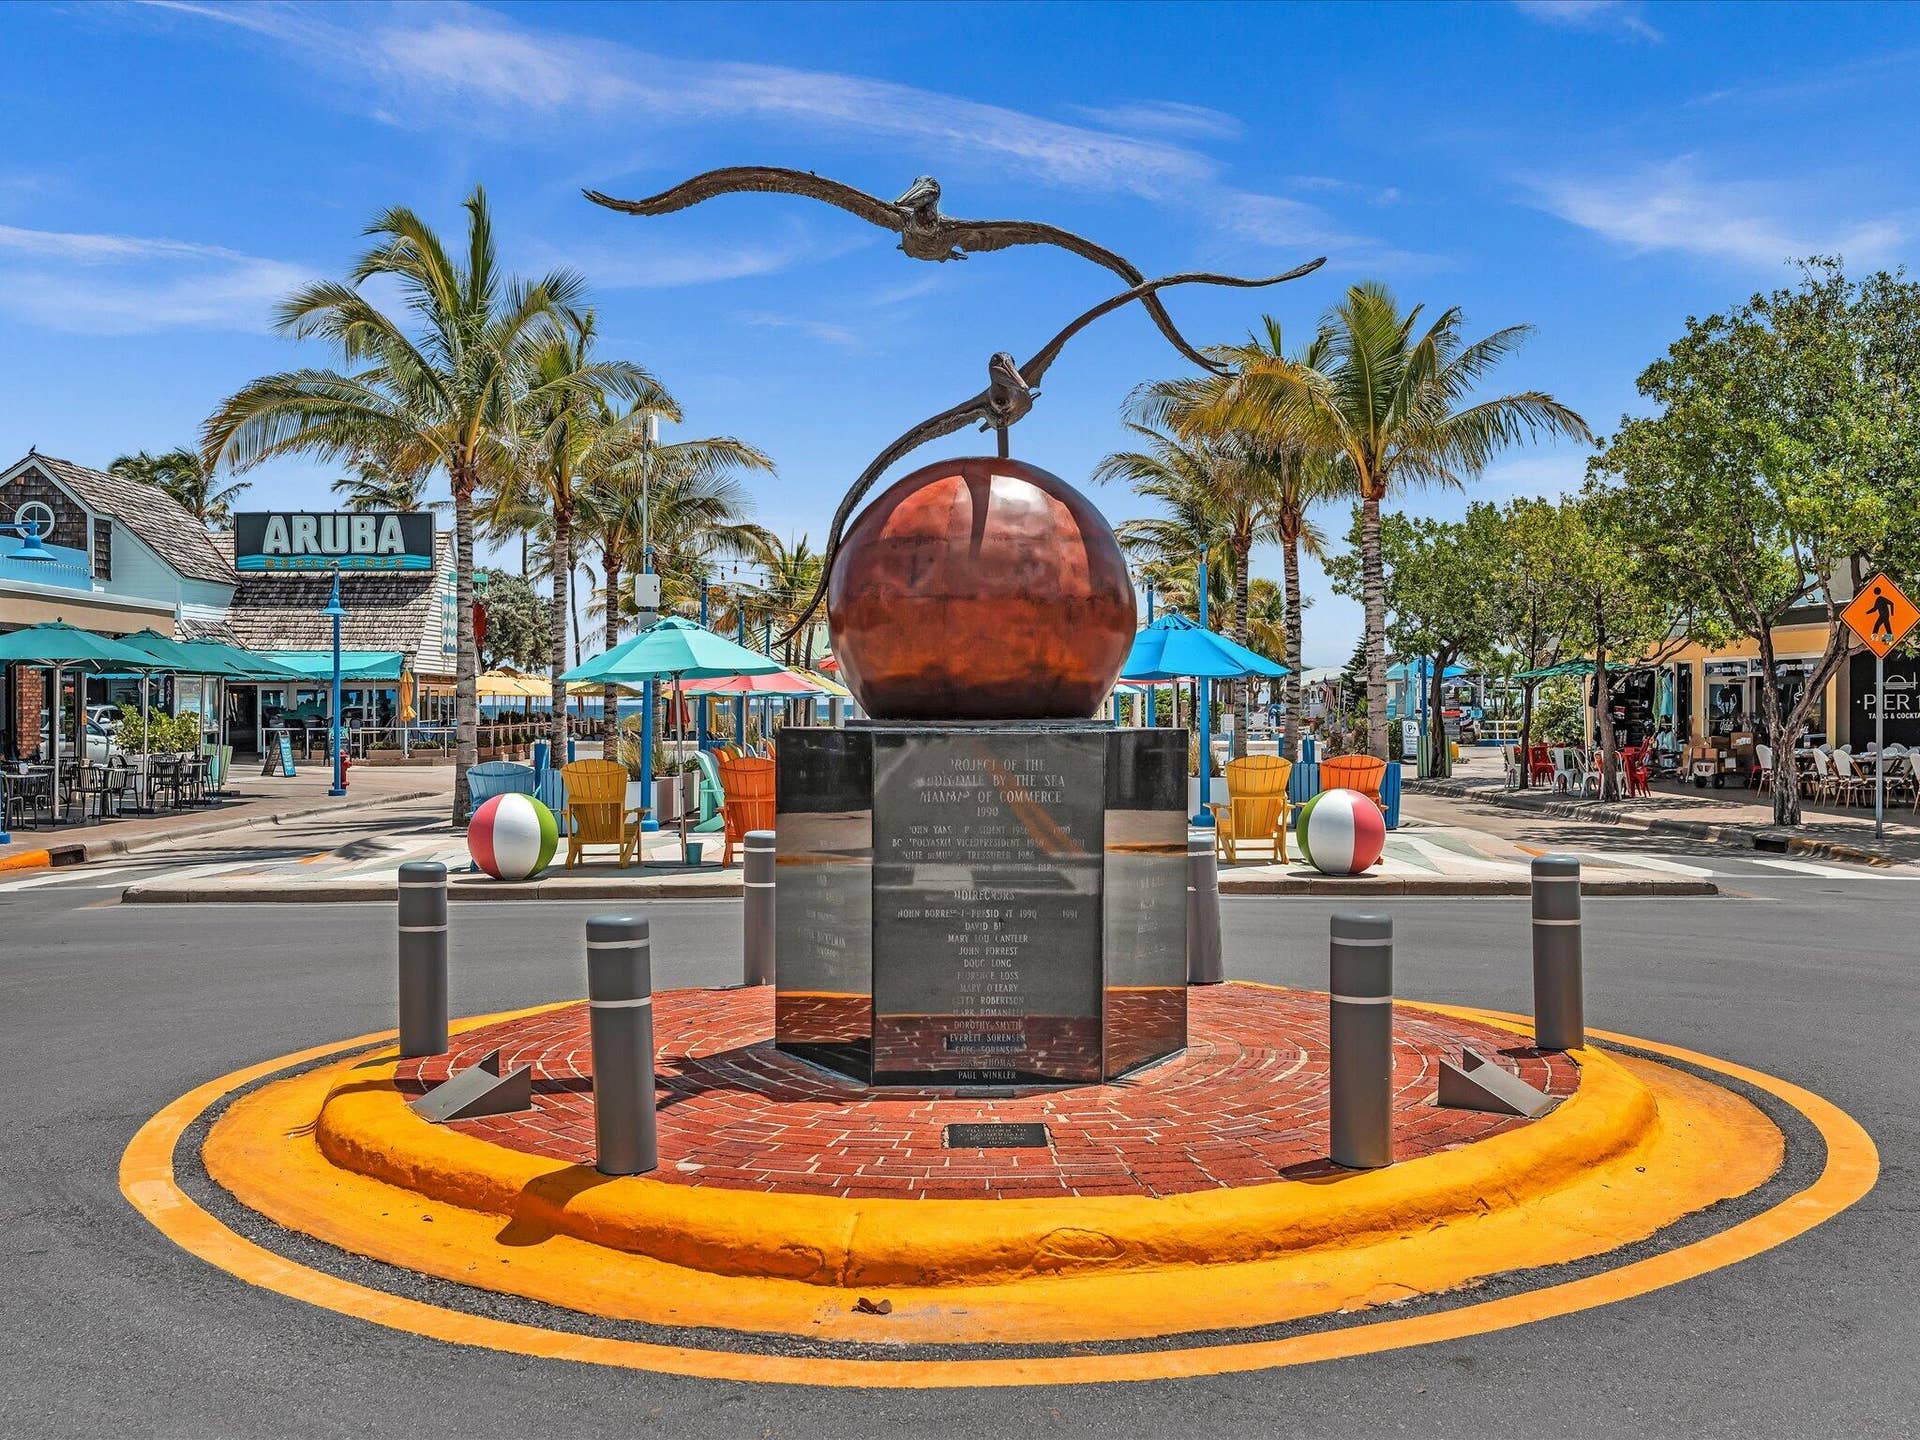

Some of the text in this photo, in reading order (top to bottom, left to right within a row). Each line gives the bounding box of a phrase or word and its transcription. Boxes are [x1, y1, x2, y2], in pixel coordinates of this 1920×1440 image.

[262, 515, 406, 554] ARUBA
[1863, 693, 1911, 711] PER
[1003, 758, 1018, 771] OF
[1025, 758, 1046, 771] THE
[993, 774, 1006, 786] BY
[1014, 774, 1037, 786] THE
[1044, 774, 1065, 786] SEA
[977, 790, 993, 803] OF
[1000, 790, 1062, 803] COMMERCE
[976, 806, 999, 817] 1990
[964, 922, 988, 931] DAVID
[947, 934, 969, 943] MARY
[958, 946, 1018, 955] JOHN FORREST
[963, 959, 1012, 968] DOUG LONG
[1000, 971, 1019, 980] LOSS
[980, 996, 1024, 1005] ROBERTSON
[949, 1033, 981, 1042] EVERETT
[958, 1071, 1017, 1080] PAUL WINKLER
